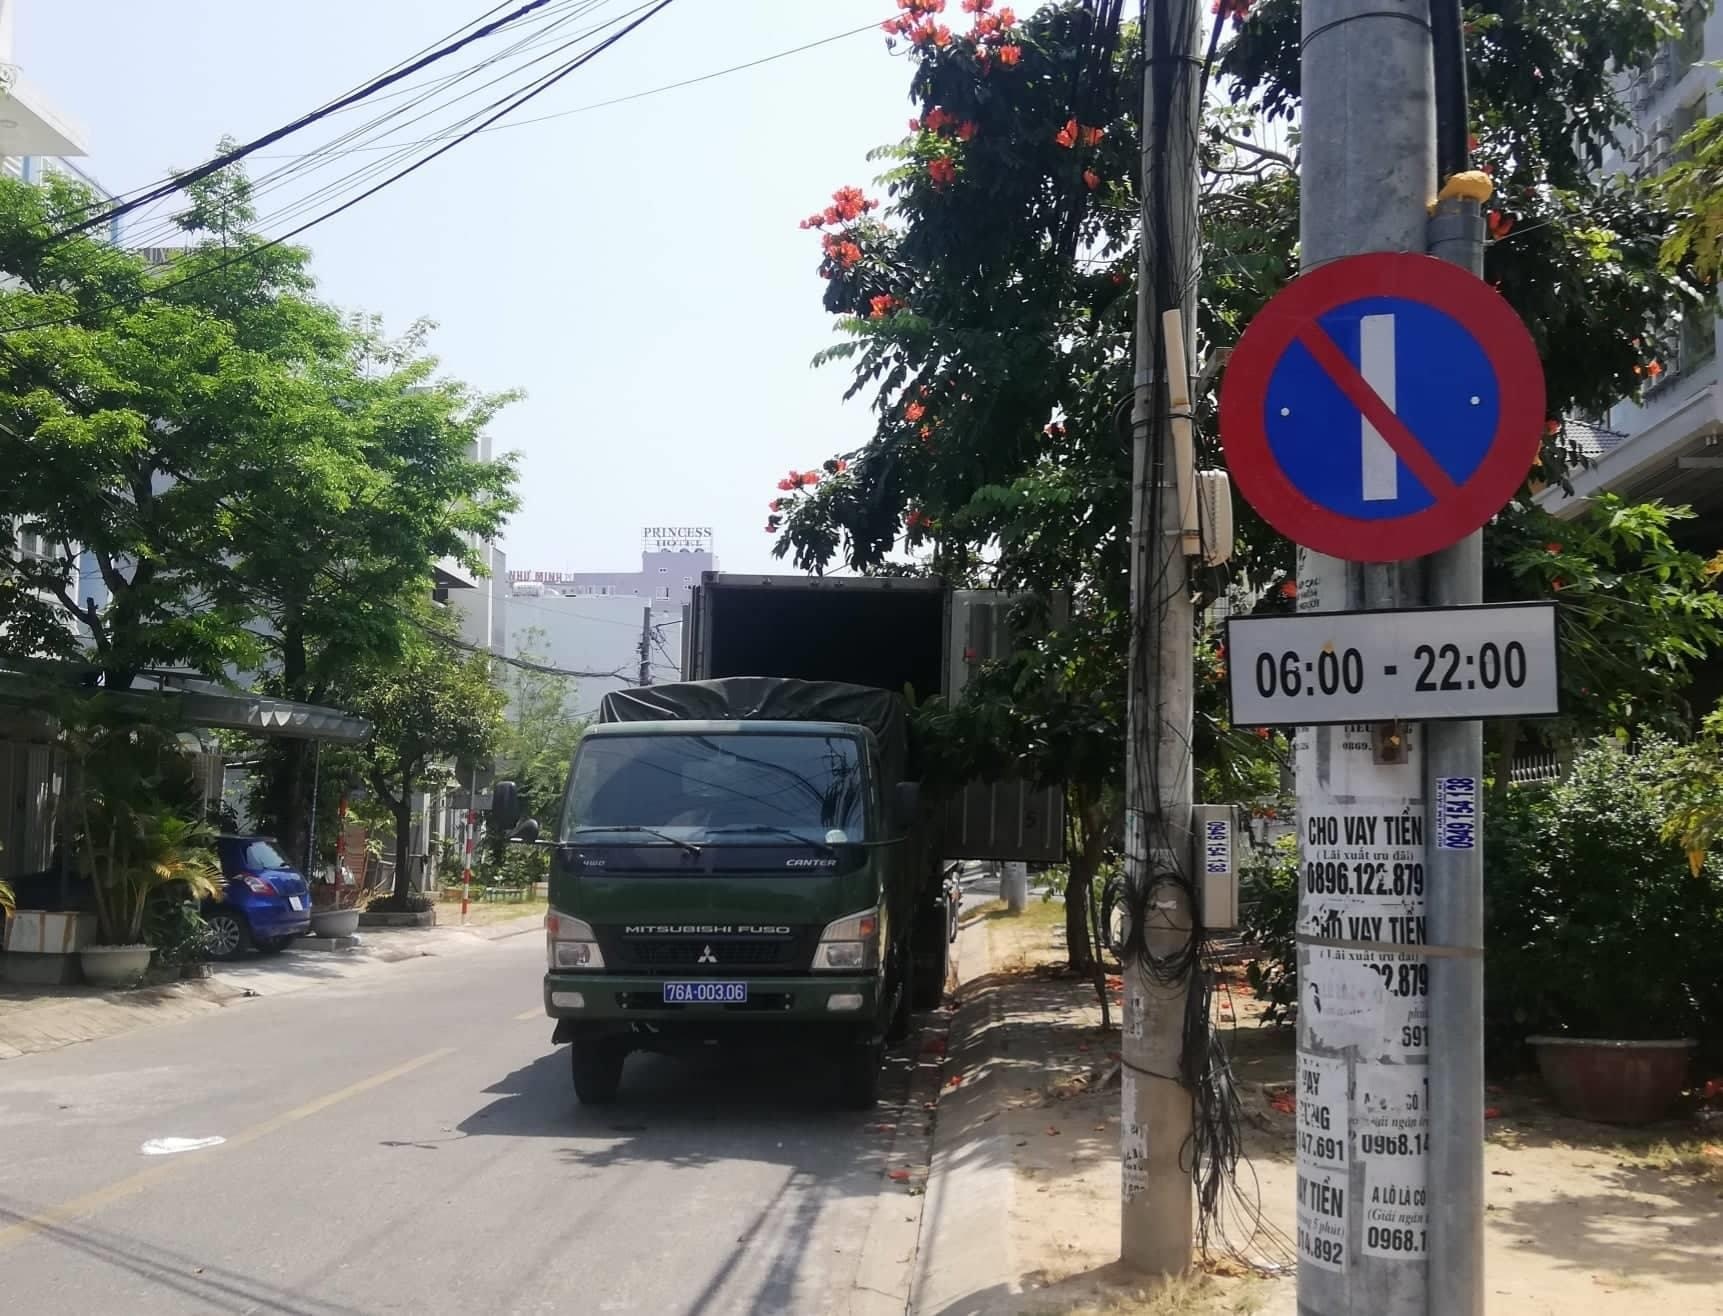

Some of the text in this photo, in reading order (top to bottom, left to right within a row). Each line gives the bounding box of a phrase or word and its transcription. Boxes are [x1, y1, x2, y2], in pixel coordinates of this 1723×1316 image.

[644, 527, 712, 538] PRINCESS
[1256, 646, 1364, 698] 06:00
[1414, 641, 1527, 692] 22:00
[1446, 778, 1474, 849] 0949.154.138
[1308, 816, 1338, 846] CHO
[1343, 816, 1377, 846] VAY
[1383, 806, 1424, 846] TIỀN
[786, 859, 837, 867] CANTER
[625, 926, 791, 934] MITSUBISHI FUSO
[1348, 917, 1382, 941] VAY
[666, 984, 745, 1001] 76A-003.06
[1310, 1175, 1343, 1218] TIỀN
[1371, 1186, 1380, 1203] A
